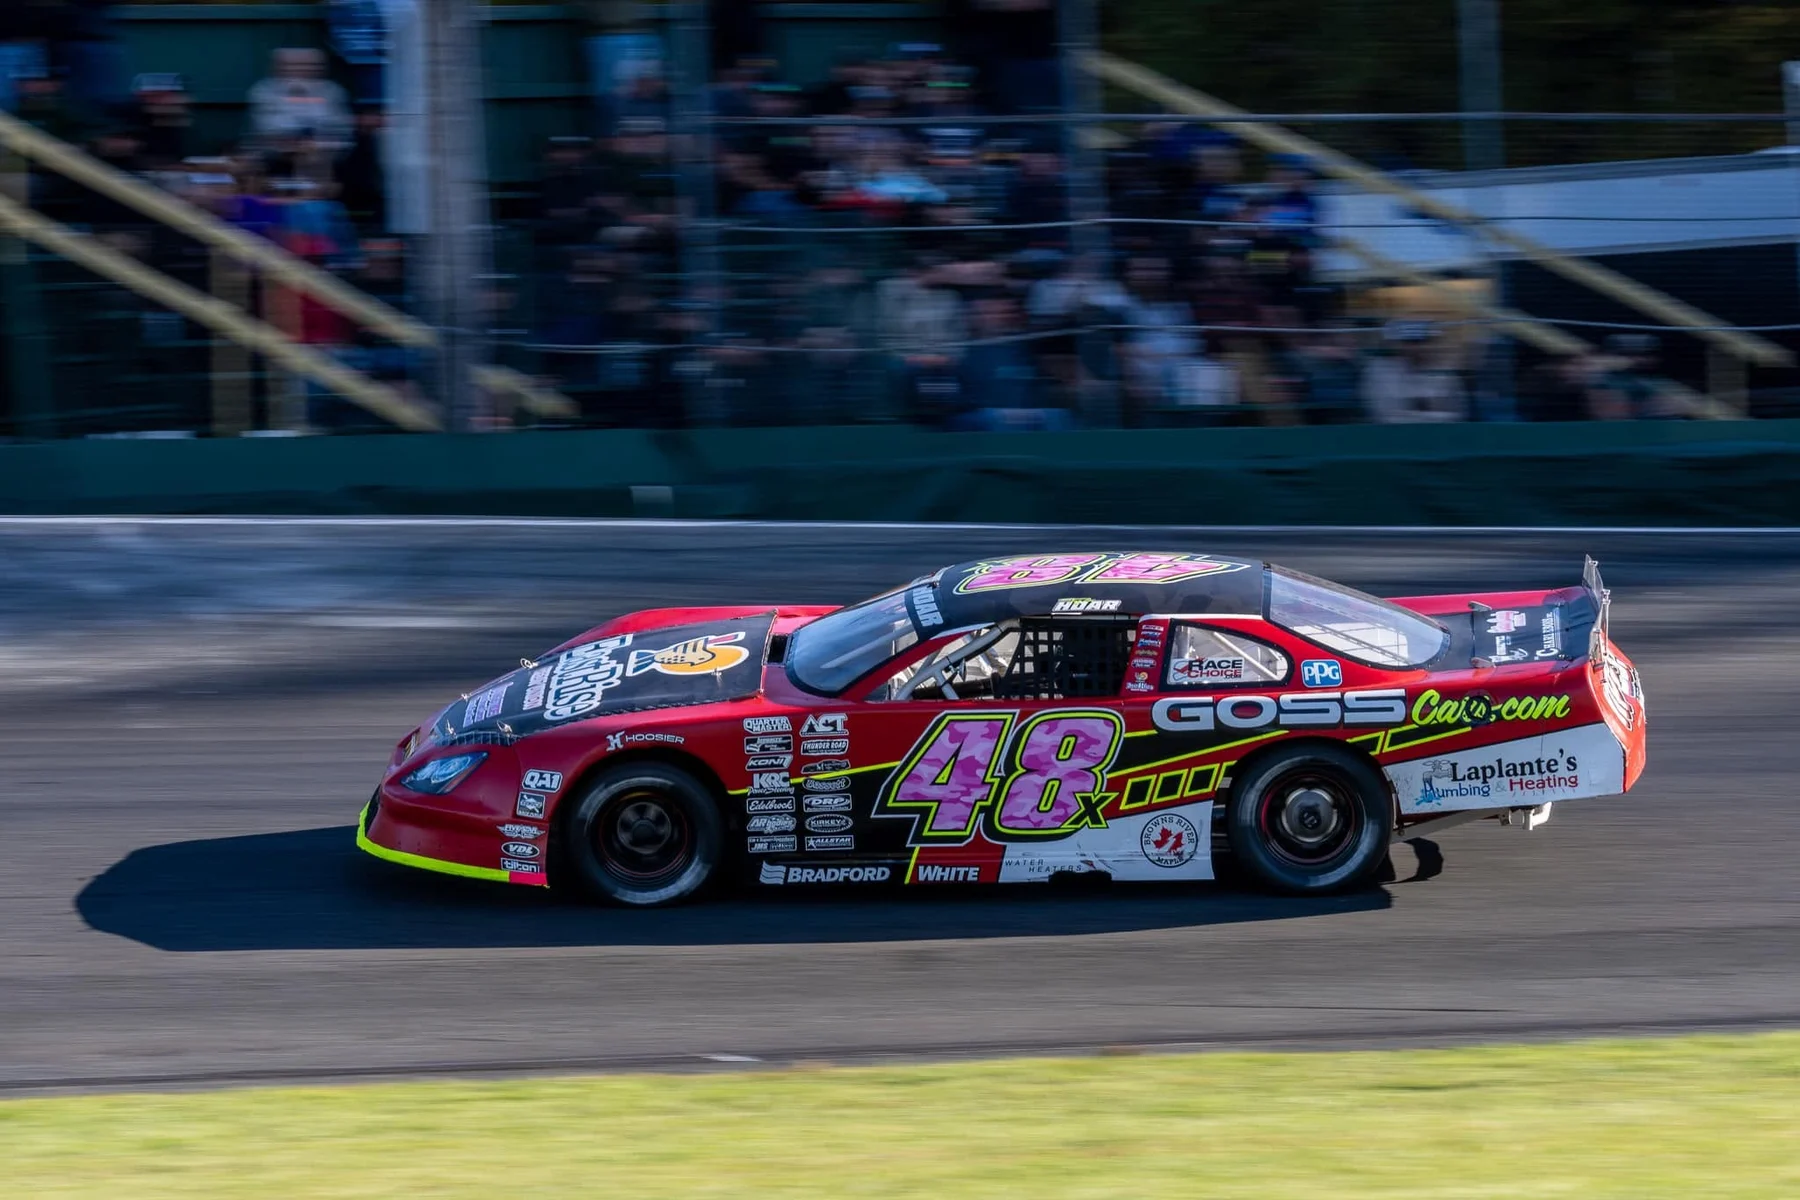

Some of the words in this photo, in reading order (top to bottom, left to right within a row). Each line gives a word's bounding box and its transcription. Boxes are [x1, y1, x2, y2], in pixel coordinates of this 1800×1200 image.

[1188, 659, 1242, 671] RACE
[1188, 669, 1242, 679] CHOICE
[1304, 661, 1340, 684] PPG
[1152, 688, 1406, 731] GOSS
[745, 718, 788, 728] QUARTER
[800, 713, 849, 733] ACT
[625, 733, 685, 745] HOOSIER
[803, 742, 830, 750] THUNDER
[831, 741, 847, 749] ROAD
[748, 758, 784, 767] KONI
[1452, 748, 1577, 784] Laplante's
[523, 771, 560, 790] QA1
[753, 772, 790, 789] KRC
[1509, 775, 1579, 792] Heating
[749, 800, 793, 811] Edelbrock
[1143, 816, 1174, 846] BROWNS
[1175, 819, 1196, 845] RIVER
[509, 844, 533, 854] VDL
[503, 860, 537, 874] tilton
[1005, 859, 1045, 867] WATER
[1156, 856, 1185, 866] MAPLE
[787, 867, 891, 883] BRADFORD
[918, 865, 980, 882] WHITE
[1028, 865, 1083, 874] HEATERS
